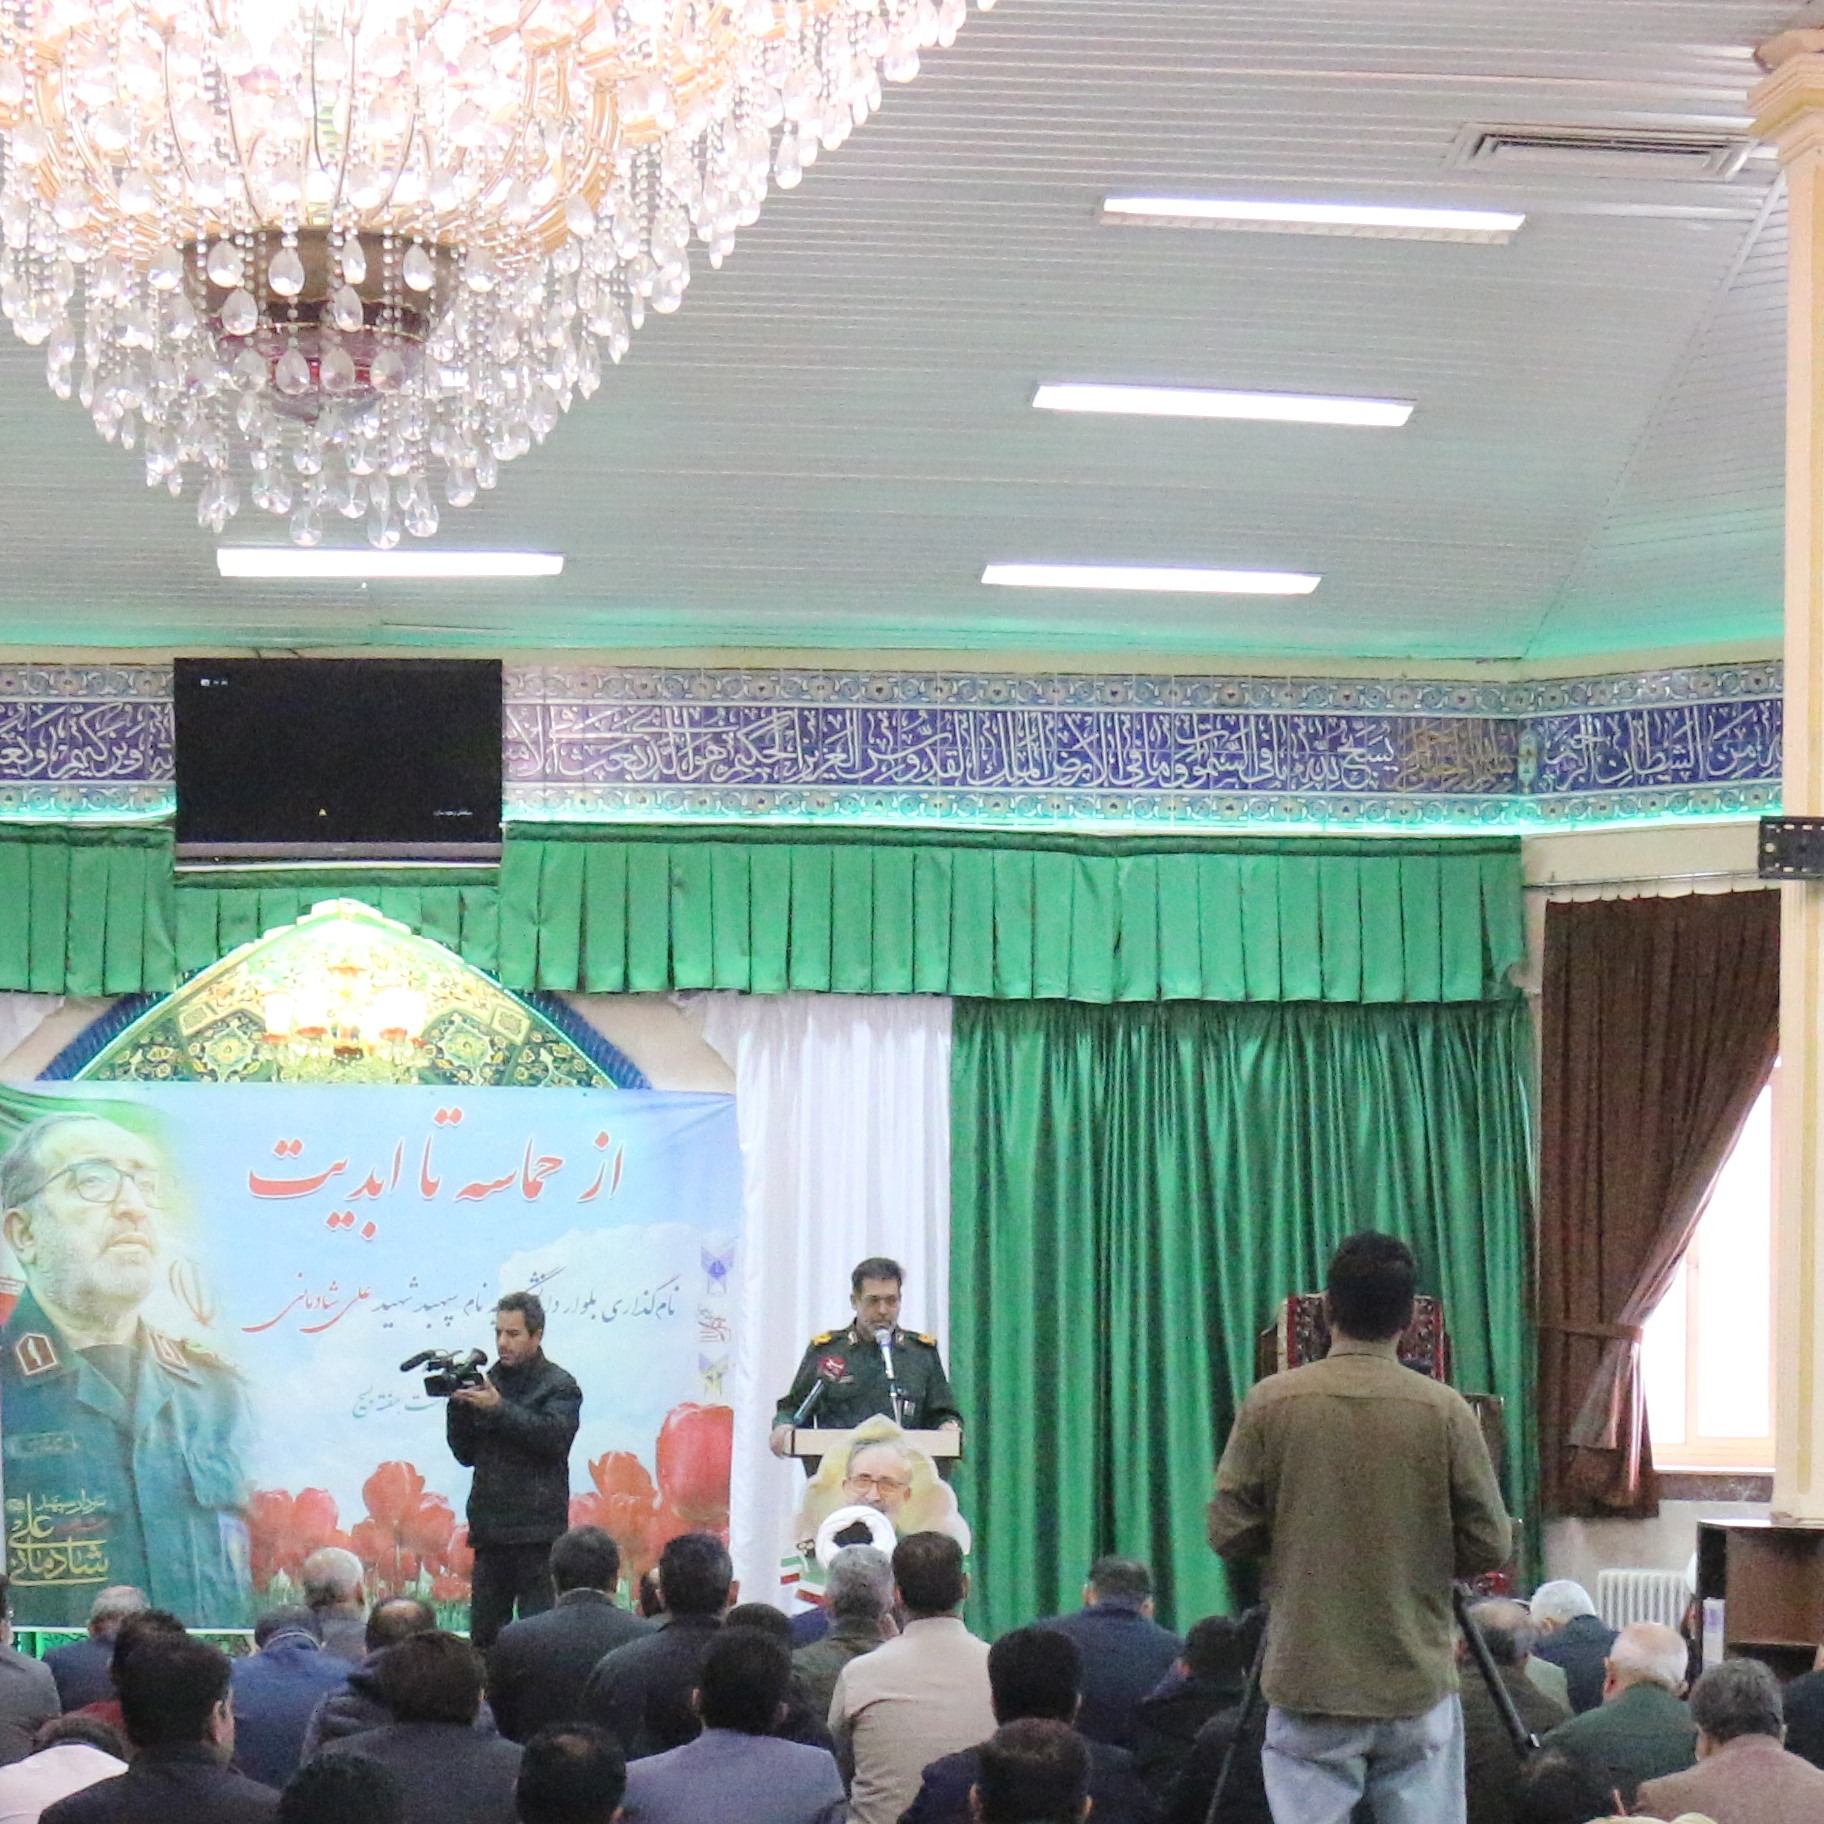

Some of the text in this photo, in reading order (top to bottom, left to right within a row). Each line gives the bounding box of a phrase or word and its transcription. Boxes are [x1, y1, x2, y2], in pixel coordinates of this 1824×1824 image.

[247, 1106, 625, 1241] از حماسه تا ابدیت
[240, 1271, 339, 1333] شادمانی
[298, 1285, 372, 1333] علی
[370, 1275, 419, 1329] شهید
[463, 1281, 488, 1317] نام
[562, 1288, 597, 1320] بلوار
